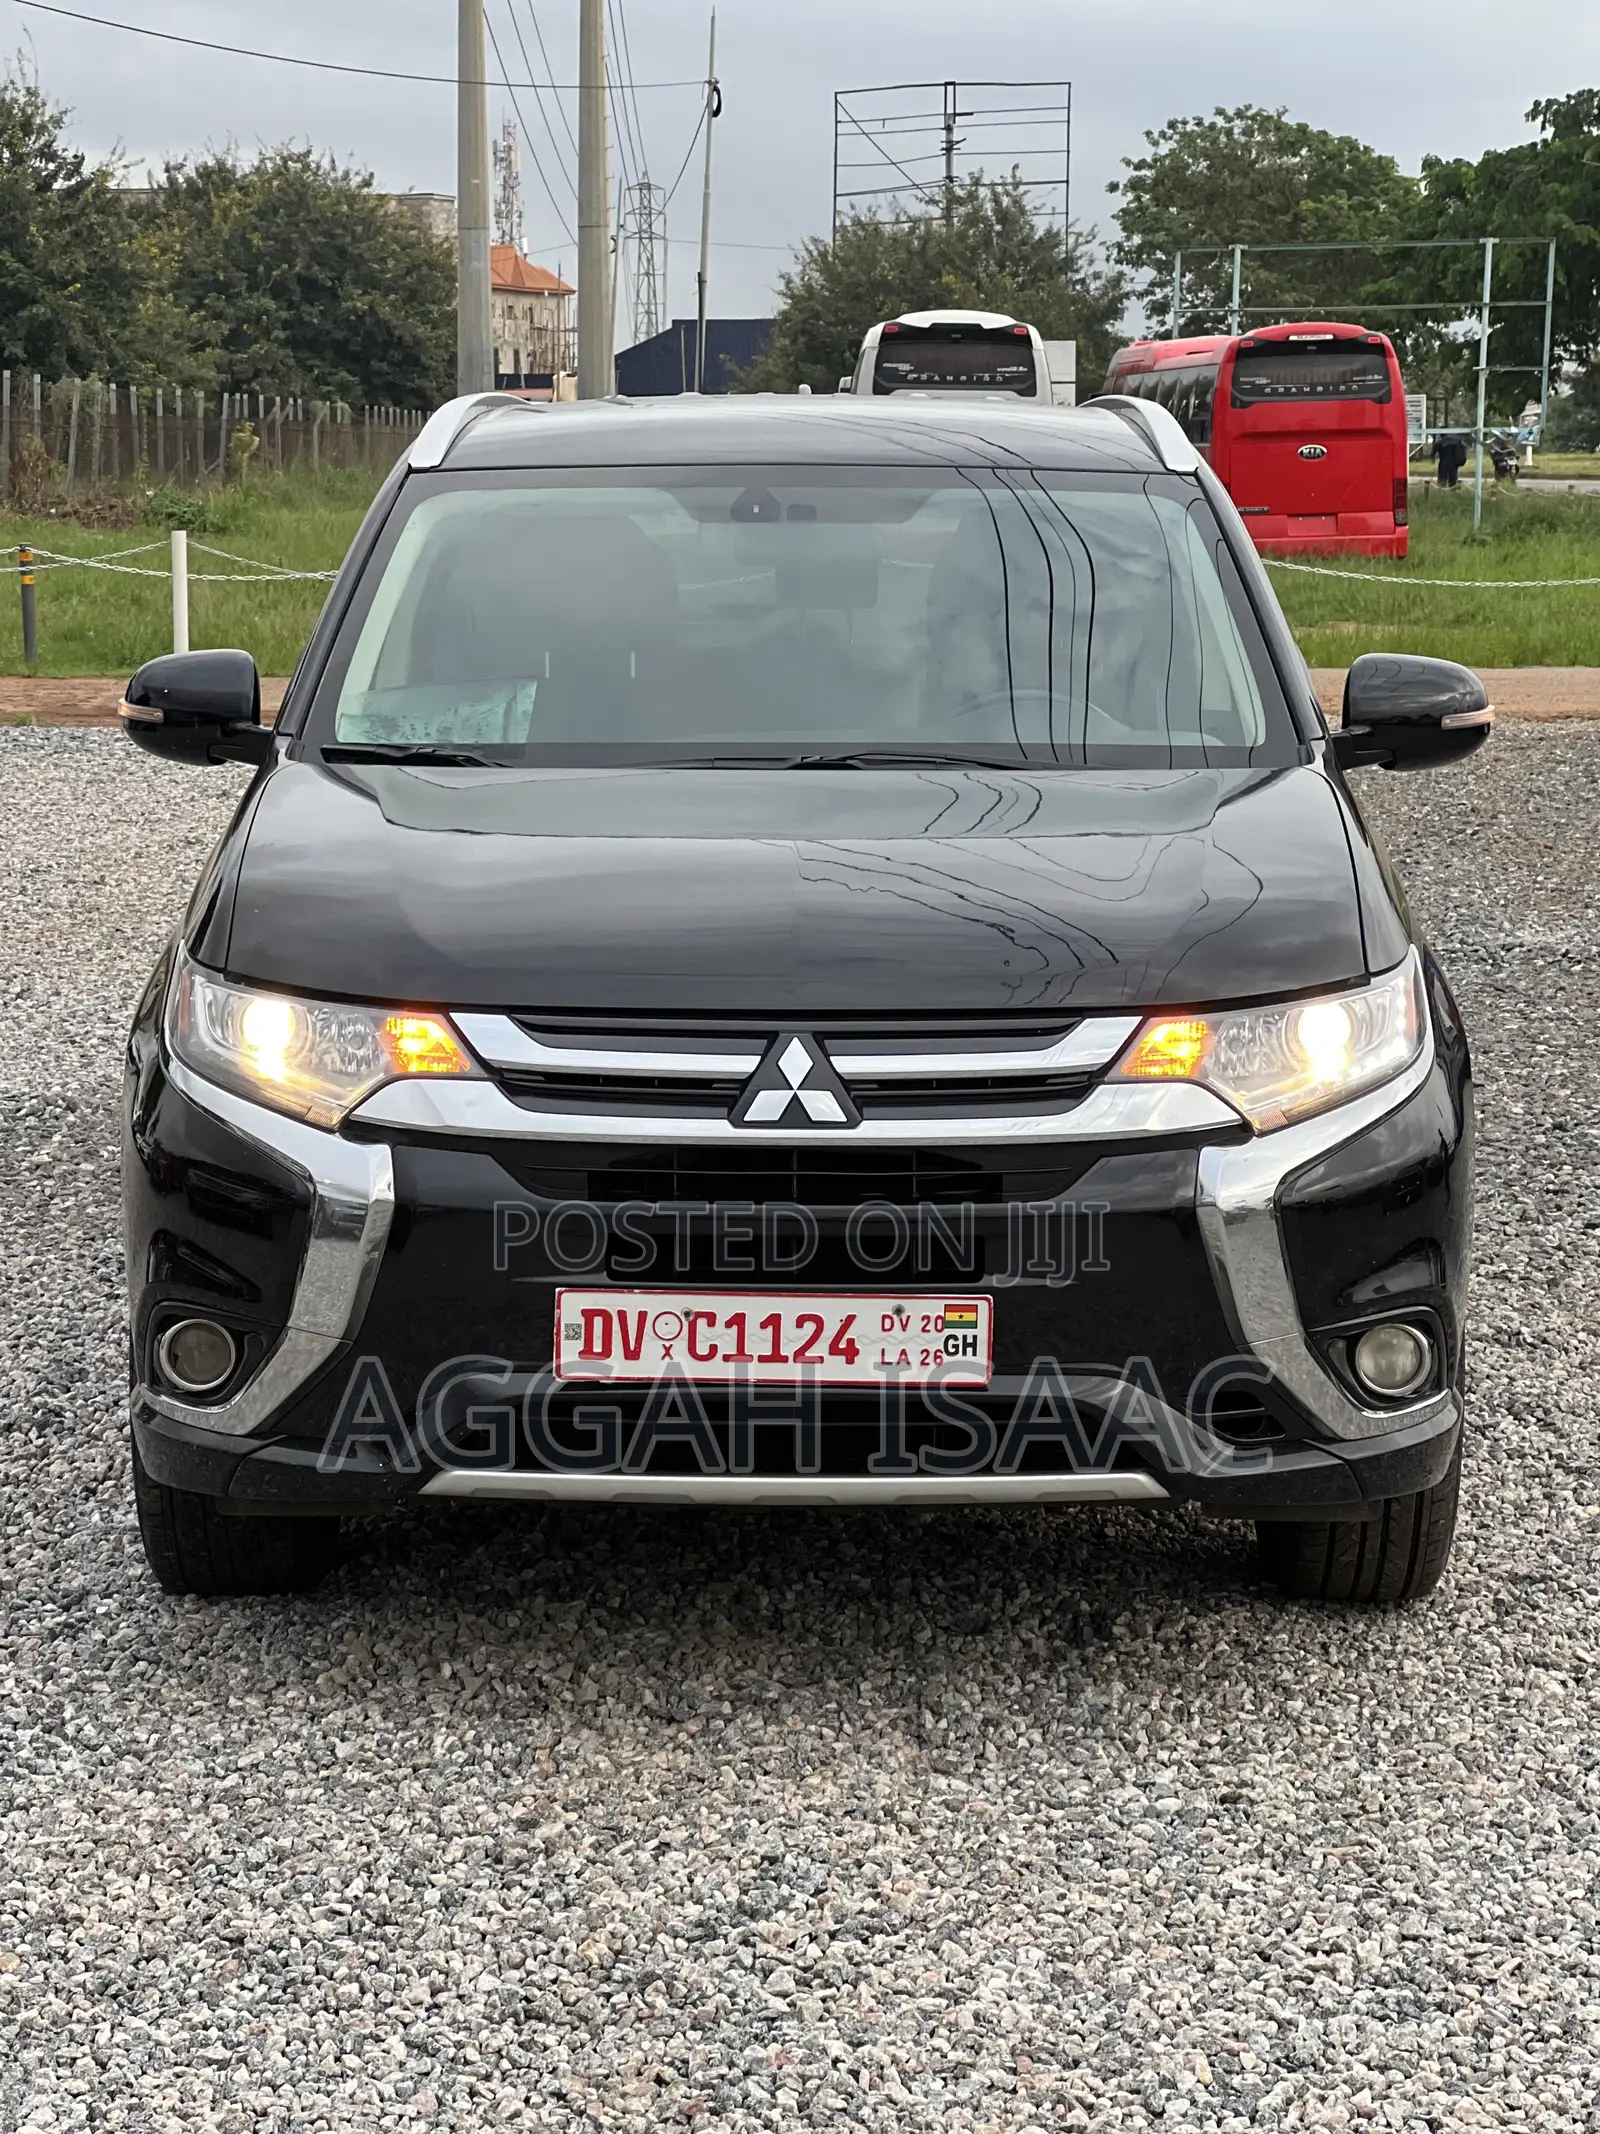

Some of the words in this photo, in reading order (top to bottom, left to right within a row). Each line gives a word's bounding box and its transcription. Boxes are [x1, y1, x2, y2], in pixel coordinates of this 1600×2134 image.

[1302, 447, 1323, 457] KIA
[881, 1313, 910, 1333] DV
[921, 1314, 945, 1333] 20
[578, 1308, 648, 1361] DV
[686, 1311, 860, 1364] C1124
[943, 1334, 978, 1358] GH
[881, 1347, 909, 1366] LA
[920, 1348, 945, 1366] 26
